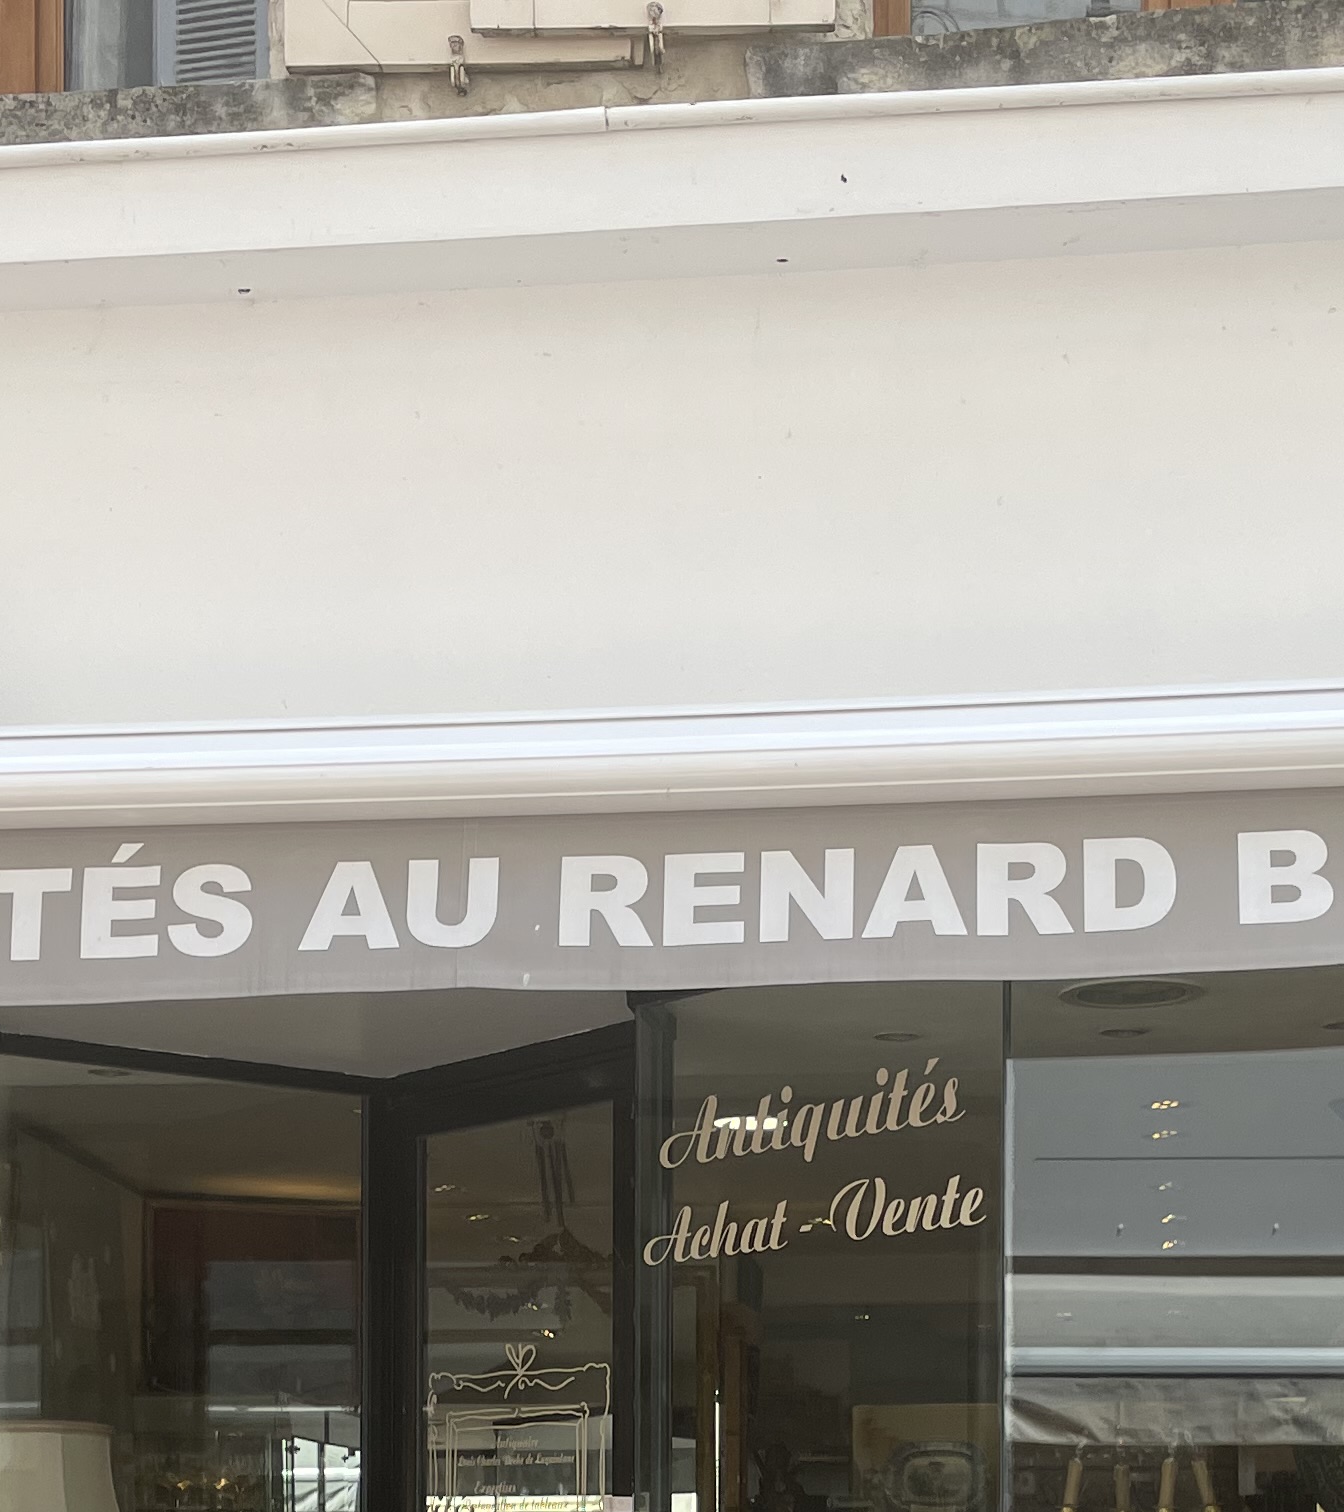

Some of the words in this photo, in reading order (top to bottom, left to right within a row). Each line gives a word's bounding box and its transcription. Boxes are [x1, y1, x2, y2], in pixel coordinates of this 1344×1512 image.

[297, 857, 500, 953] AU
[557, 836, 1177, 947] RENARD
[658, 1057, 967, 1170] Antiquités
[642, 1201, 790, 1266] Achat
[828, 1174, 988, 1242] Vente
